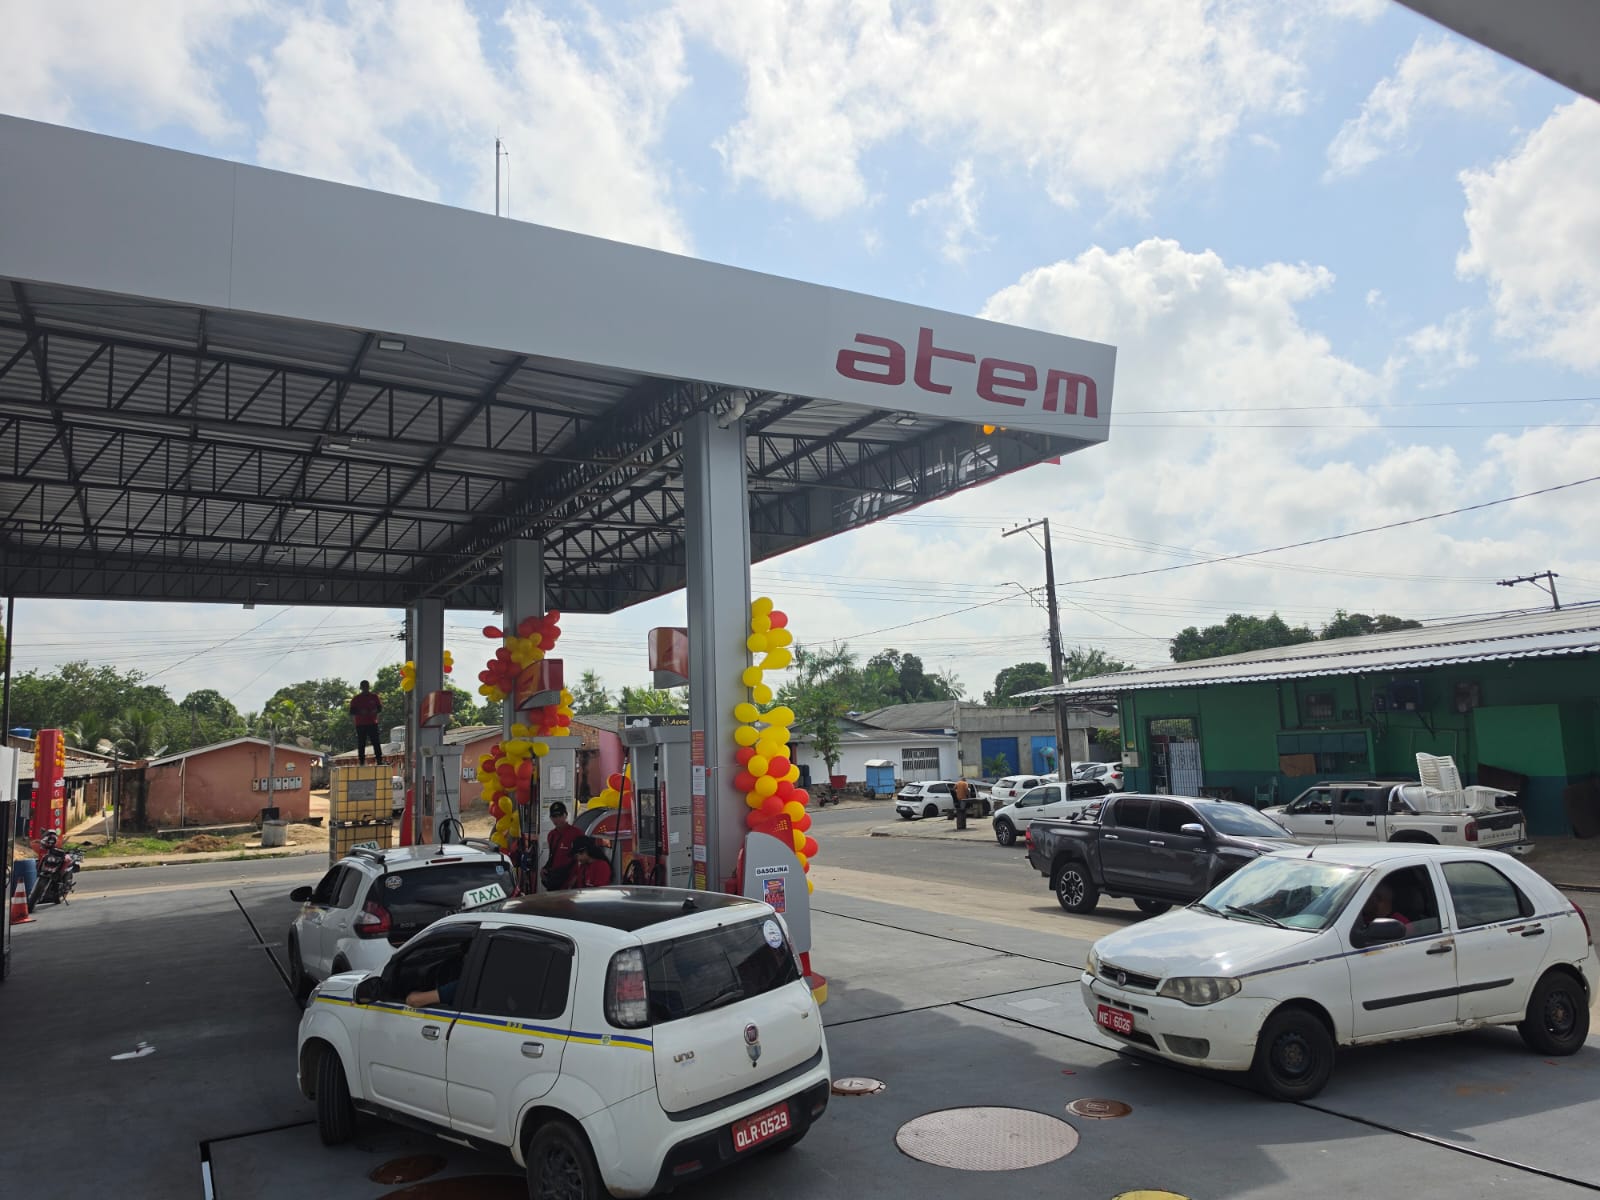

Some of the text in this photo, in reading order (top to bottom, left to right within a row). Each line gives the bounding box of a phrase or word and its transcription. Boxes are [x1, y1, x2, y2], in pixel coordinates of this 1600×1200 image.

[836, 327, 1098, 418] atem
[756, 866, 788, 875] GASOLINA
[469, 886, 501, 904] TAXI
